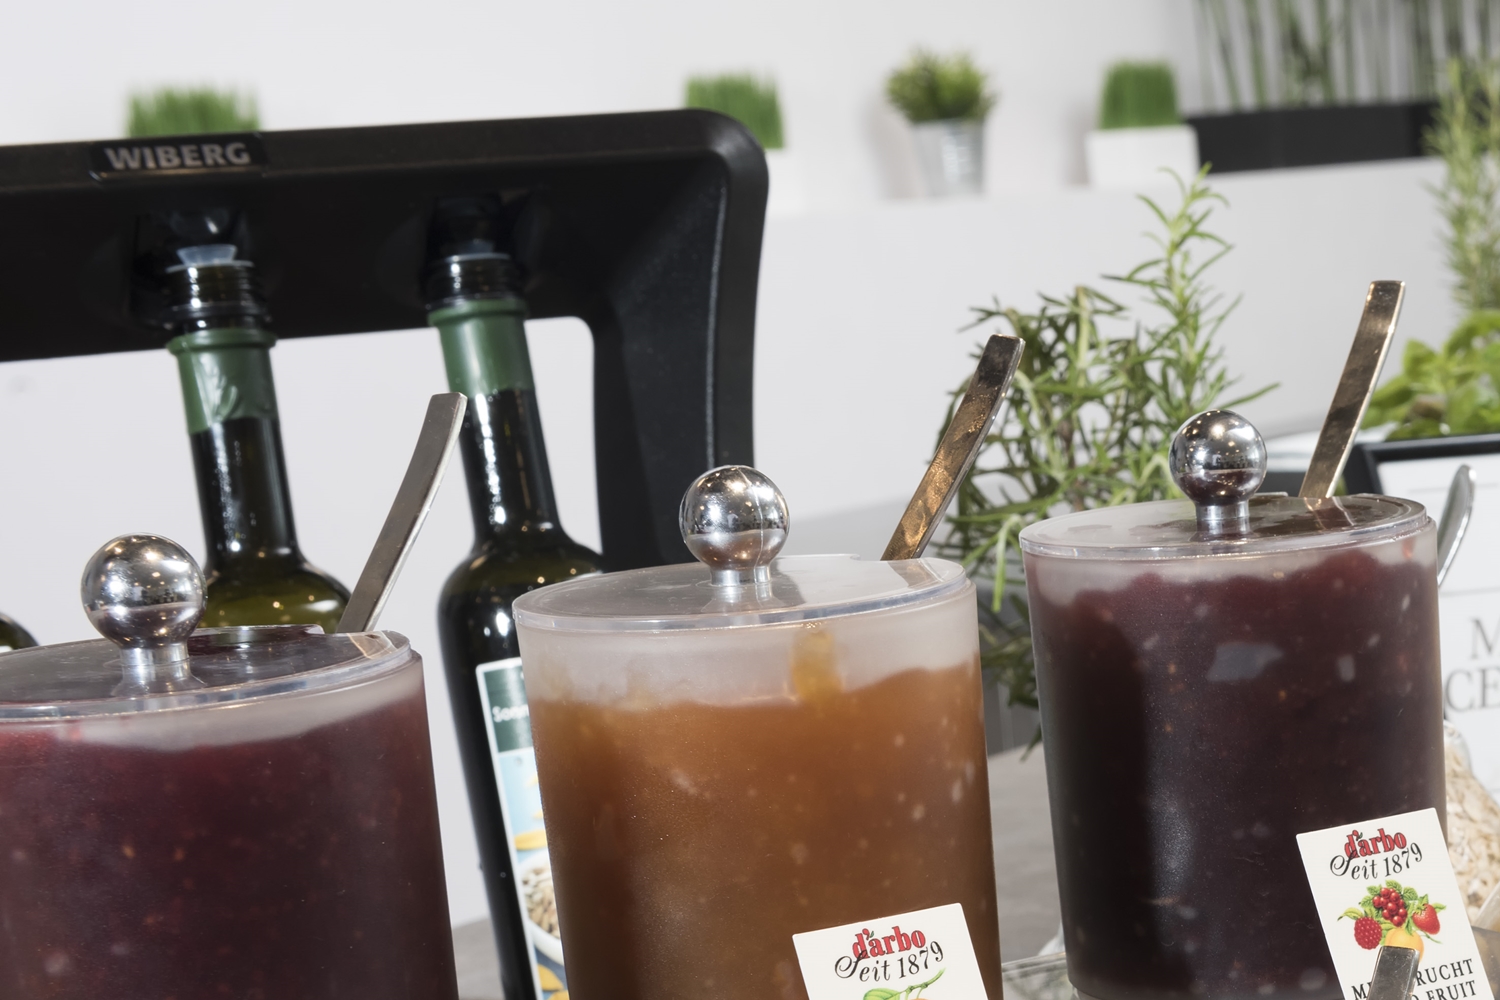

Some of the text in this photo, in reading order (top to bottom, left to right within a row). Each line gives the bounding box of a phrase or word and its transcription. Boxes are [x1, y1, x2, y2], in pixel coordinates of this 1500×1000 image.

[104, 142, 252, 170] WIBERG
[1330, 842, 1423, 880] Seit 1879
[834, 941, 944, 982] Seit 1879
